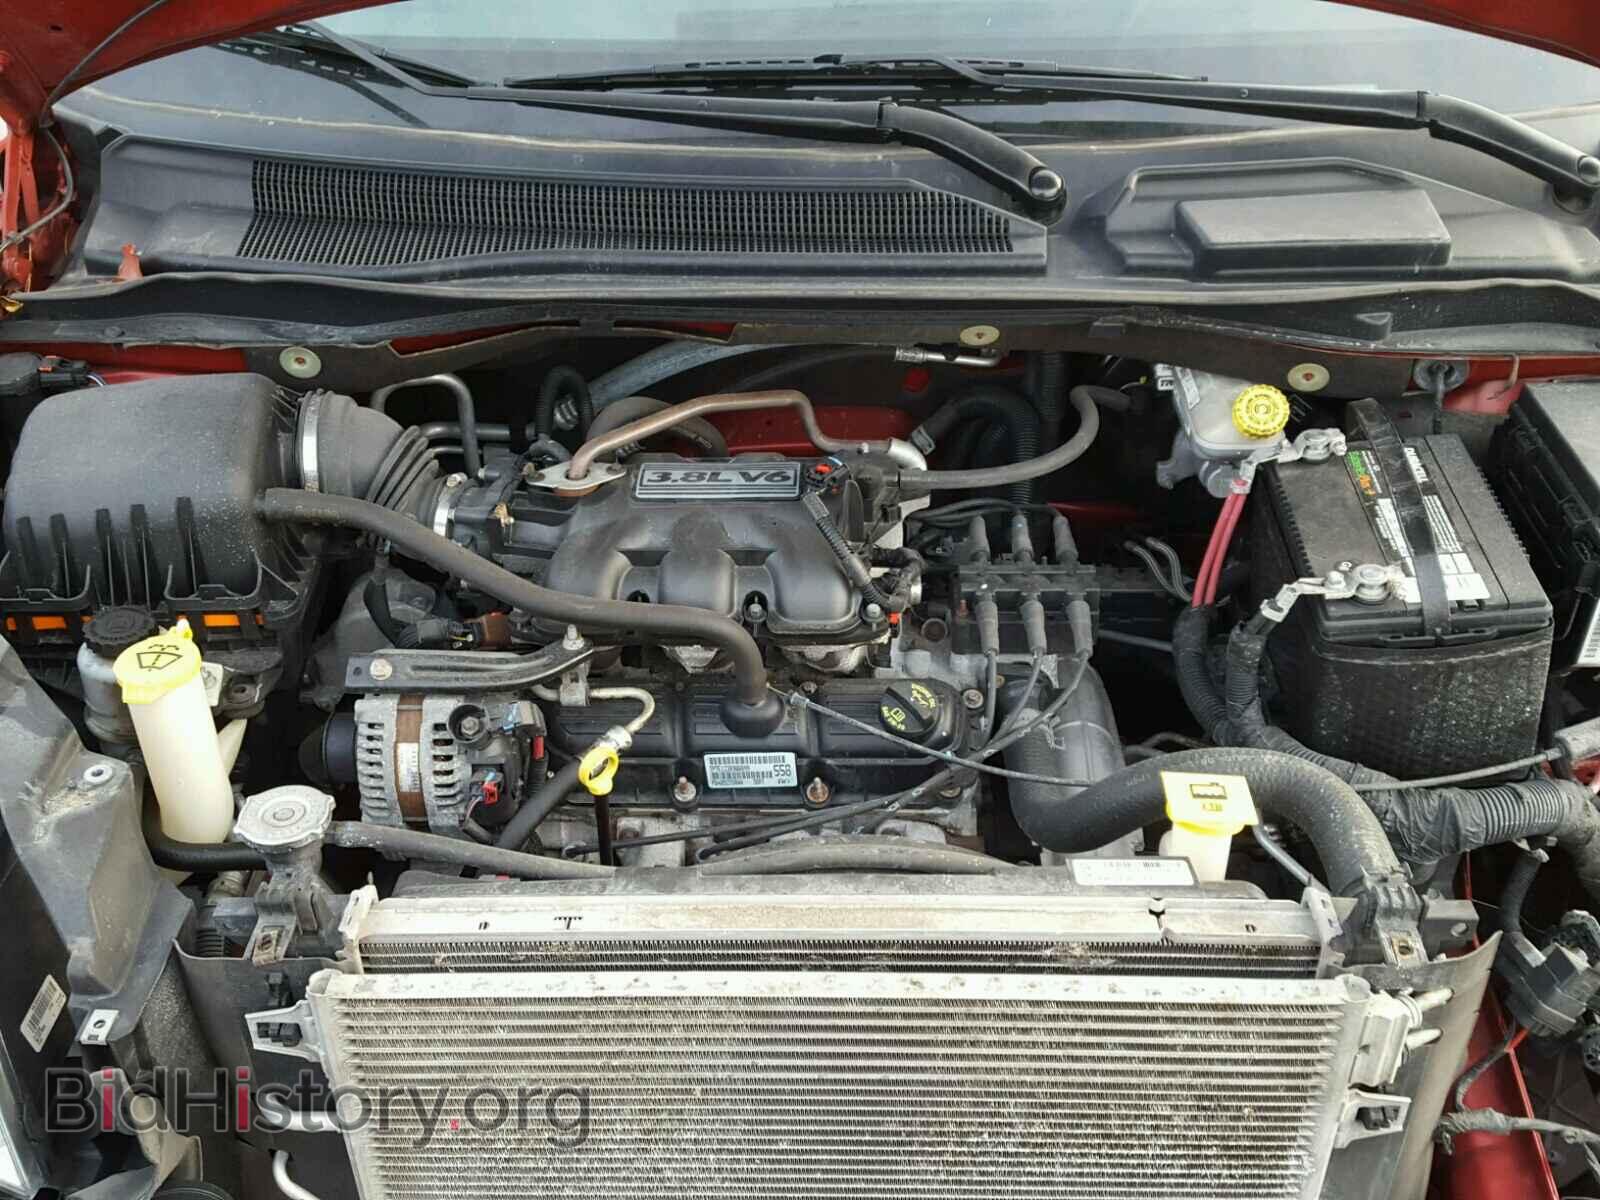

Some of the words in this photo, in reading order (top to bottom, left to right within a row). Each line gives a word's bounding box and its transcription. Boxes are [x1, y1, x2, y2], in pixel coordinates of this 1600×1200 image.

[647, 471, 732, 483] 3.8L
[738, 470, 791, 483] V6
[772, 764, 792, 777] 558
